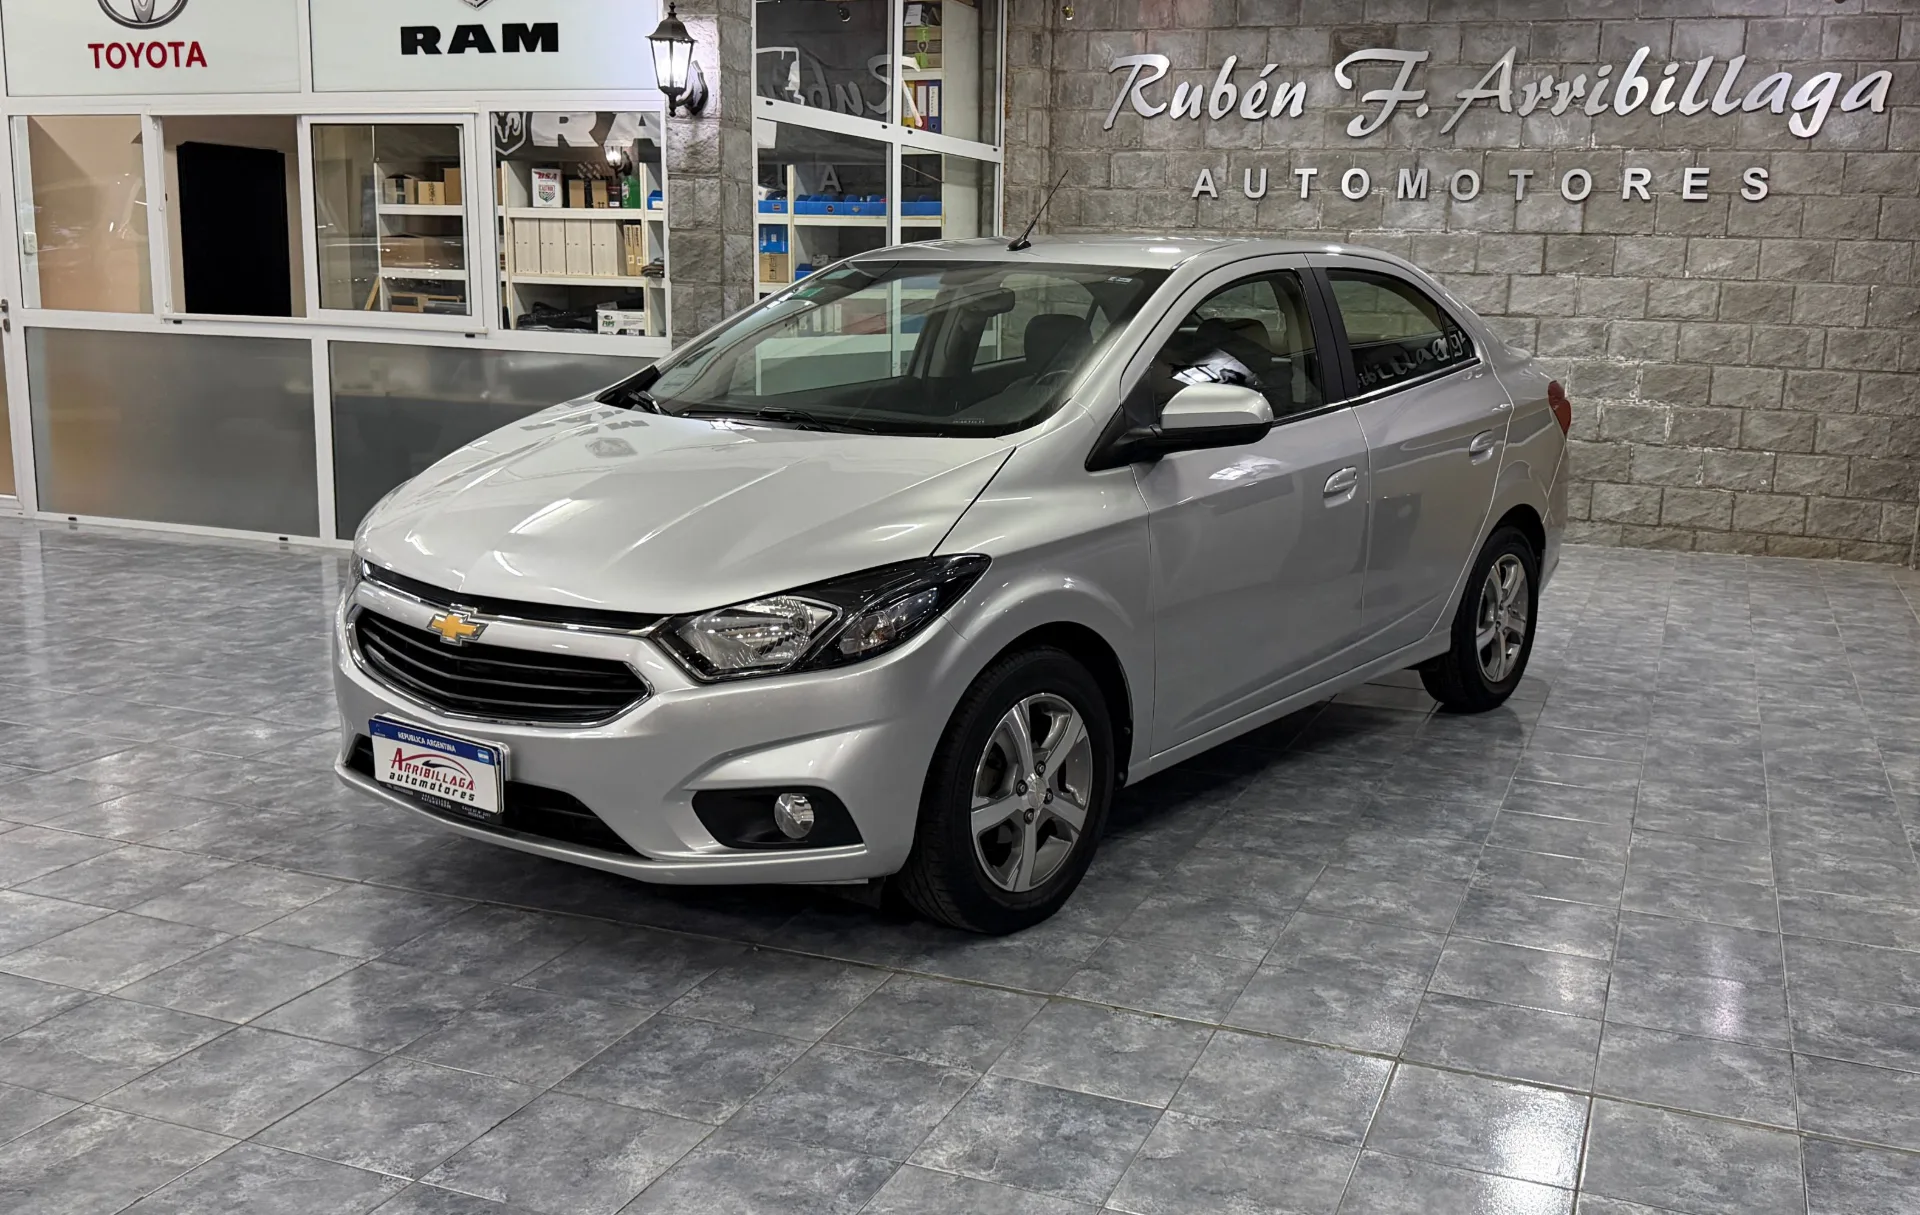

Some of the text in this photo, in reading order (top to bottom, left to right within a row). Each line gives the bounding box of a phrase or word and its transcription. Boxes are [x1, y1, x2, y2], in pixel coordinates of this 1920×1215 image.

[87, 41, 208, 69] TOYOTA
[400, 22, 559, 55] RAM
[1104, 46, 1894, 138] Rubén F. Arribillaga
[1191, 167, 1770, 201] AUTOMOTORES
[426, 739, 457, 753] ARGENTINA
[390, 747, 475, 791] ARRIBILLAGA
[389, 771, 475, 802] automotores
